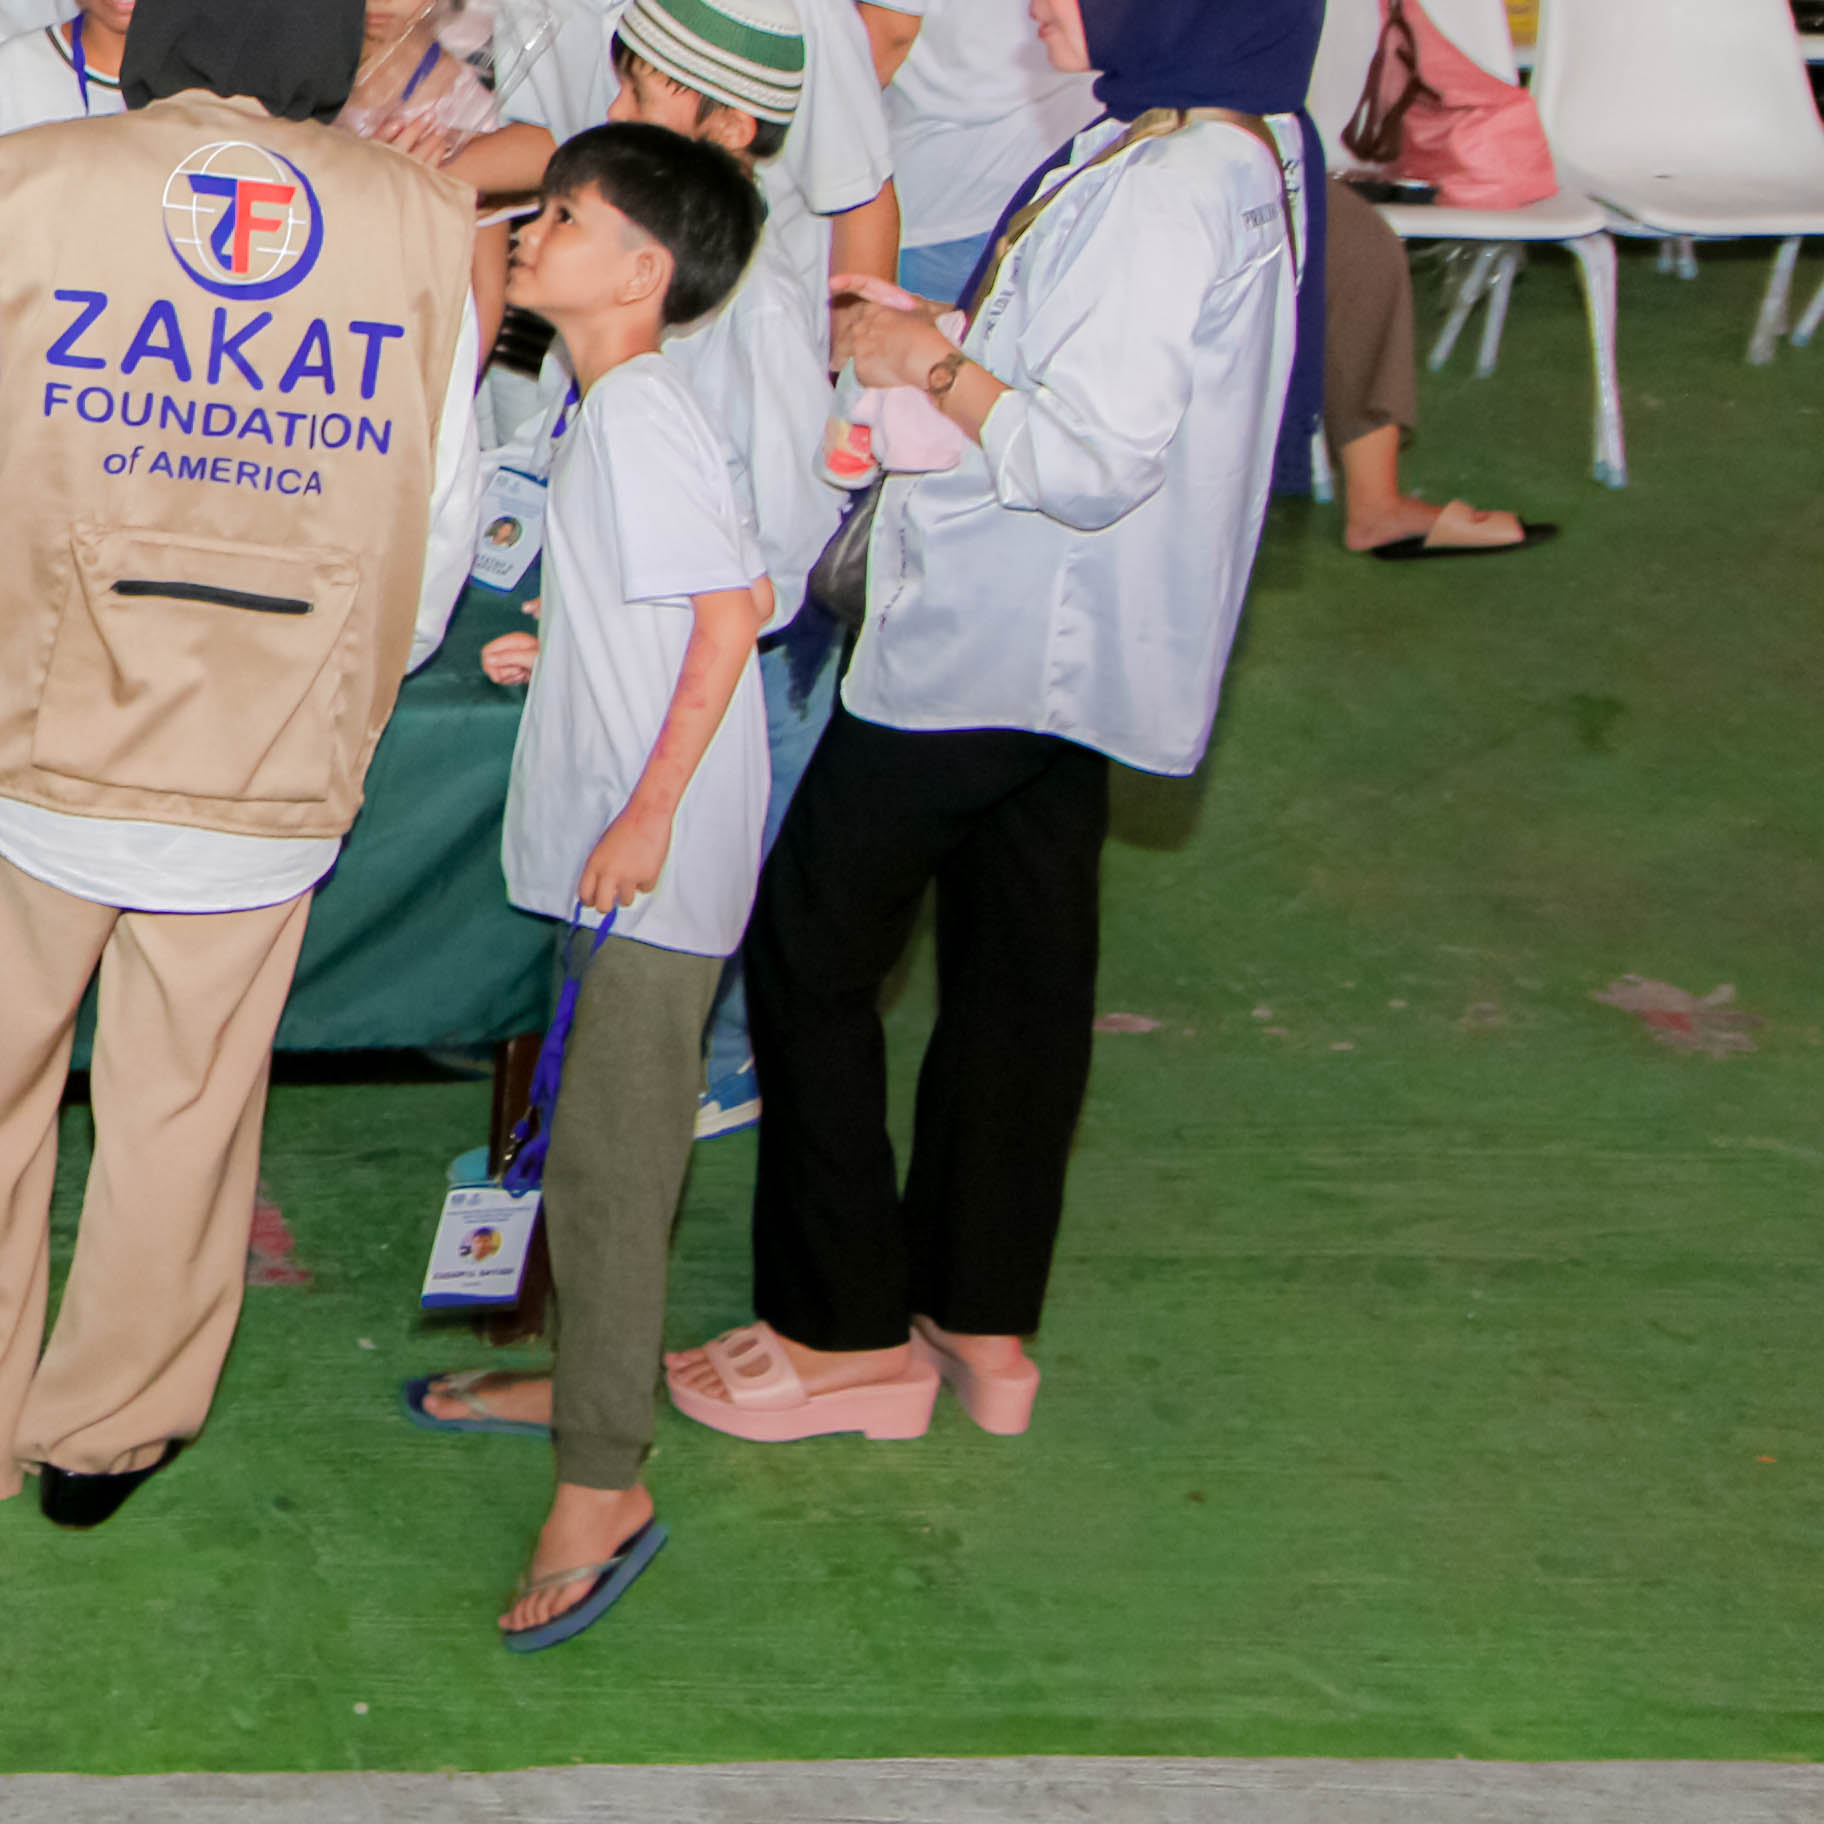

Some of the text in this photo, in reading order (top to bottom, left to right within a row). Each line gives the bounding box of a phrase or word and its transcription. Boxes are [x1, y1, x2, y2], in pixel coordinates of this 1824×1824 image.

[46, 289, 405, 400] ZAKAT
[43, 382, 392, 455] FOUNDATION
[103, 445, 322, 495] of AMERICA
